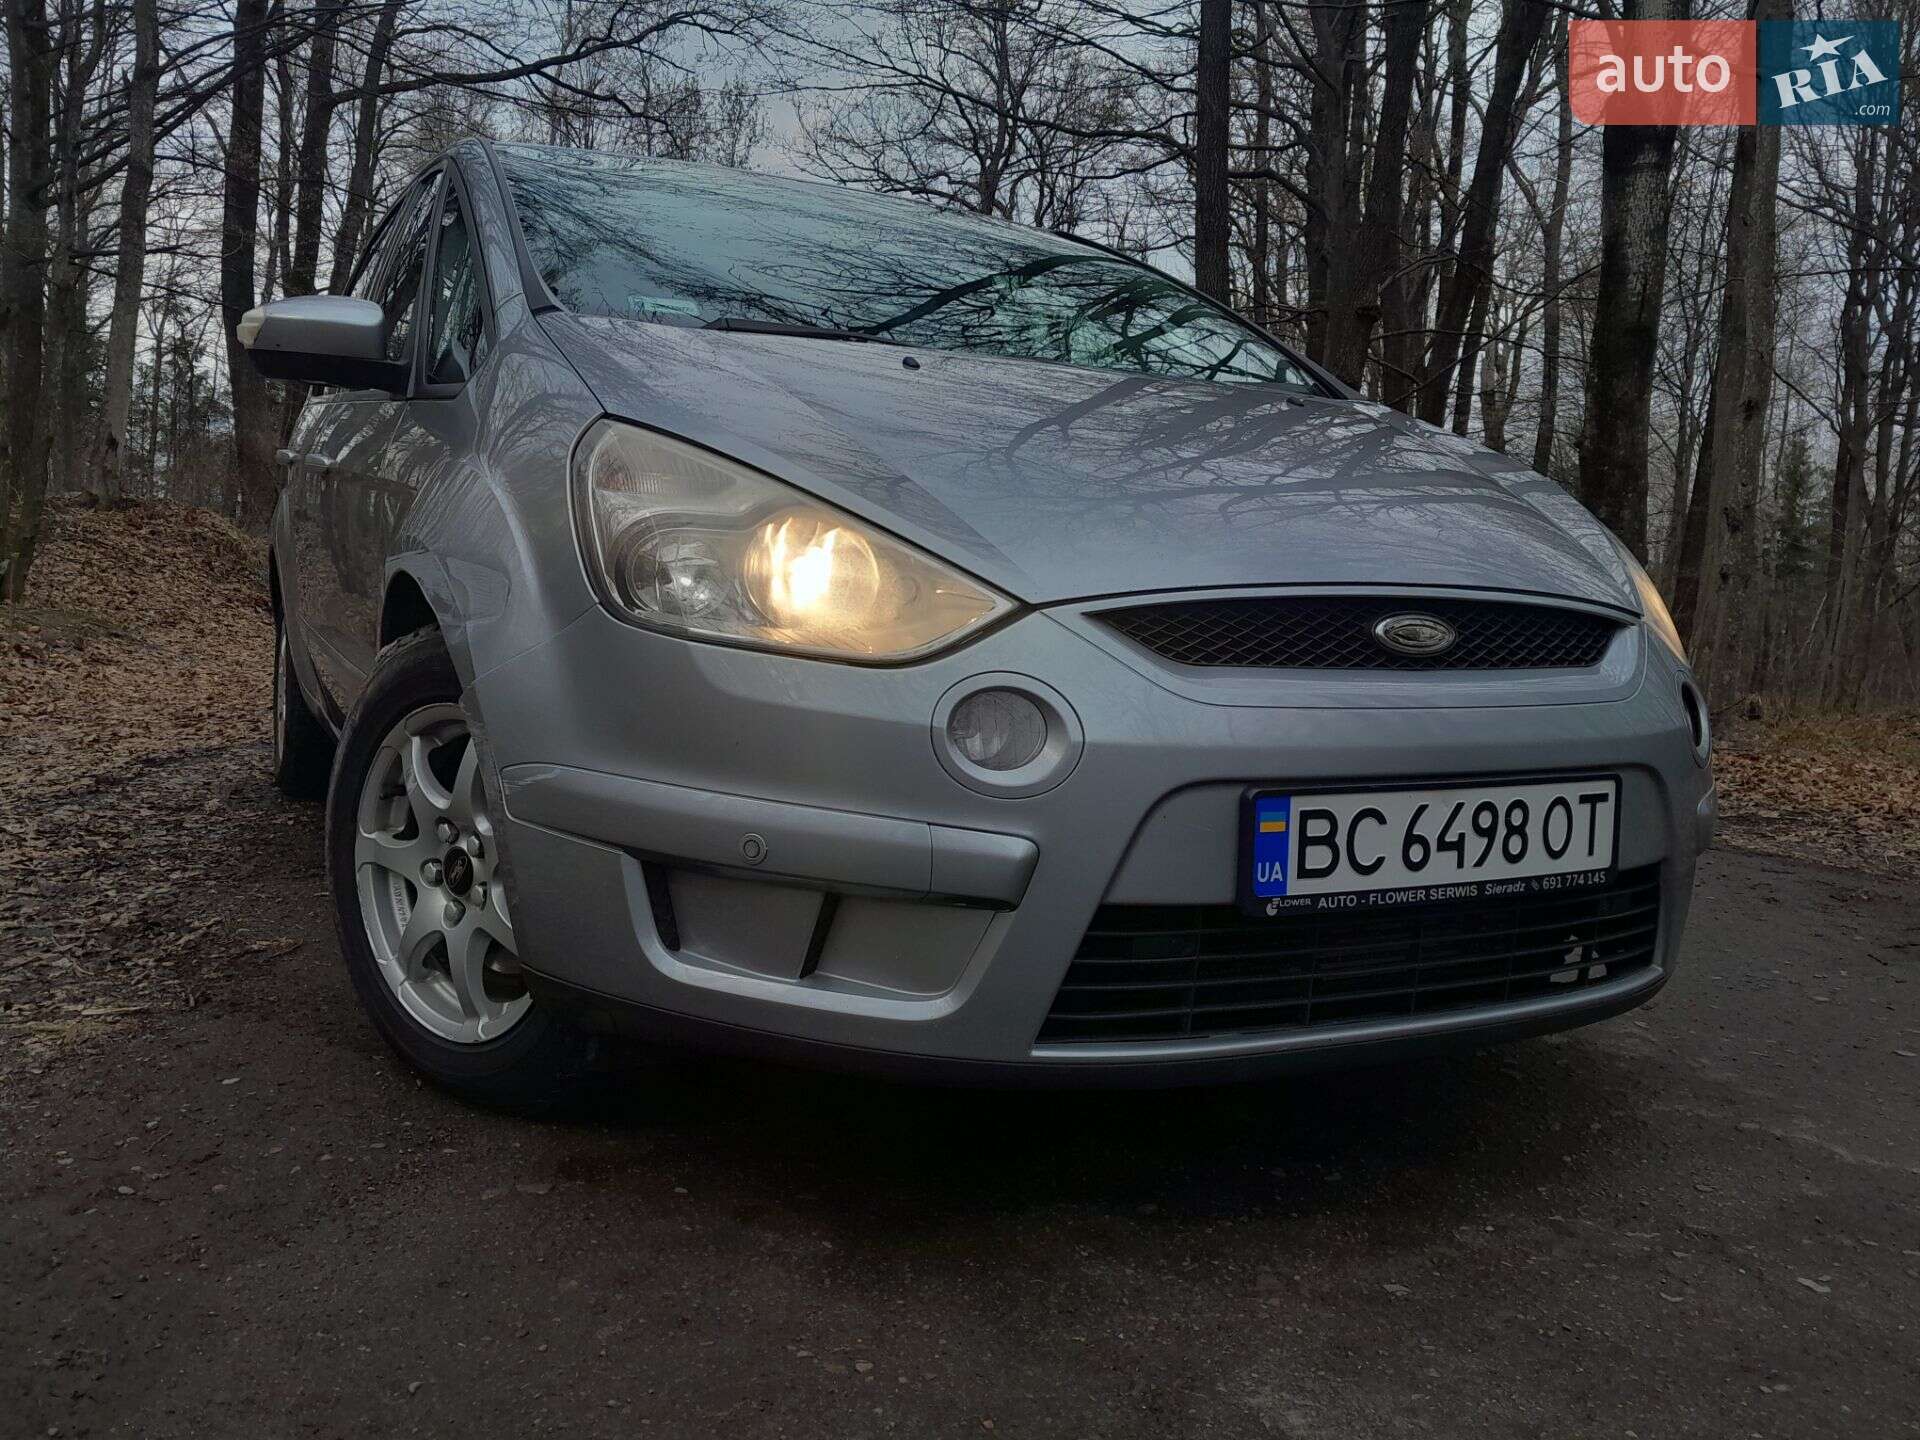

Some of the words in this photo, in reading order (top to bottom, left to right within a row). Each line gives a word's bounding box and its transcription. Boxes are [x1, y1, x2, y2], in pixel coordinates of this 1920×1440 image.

[1296, 807, 1388, 880] BC
[1401, 798, 1531, 872] 6498
[1542, 792, 1610, 860] OT
[1257, 862, 1283, 883] UA
[1318, 895, 1357, 909] AUTO
[1369, 890, 1426, 905] FLOWER
[1429, 885, 1478, 900] SERWIS
[1484, 881, 1526, 895] Sieradz
[1542, 876, 1563, 889] 691
[1565, 873, 1585, 887] 774
[1587, 871, 1606, 885] 145
